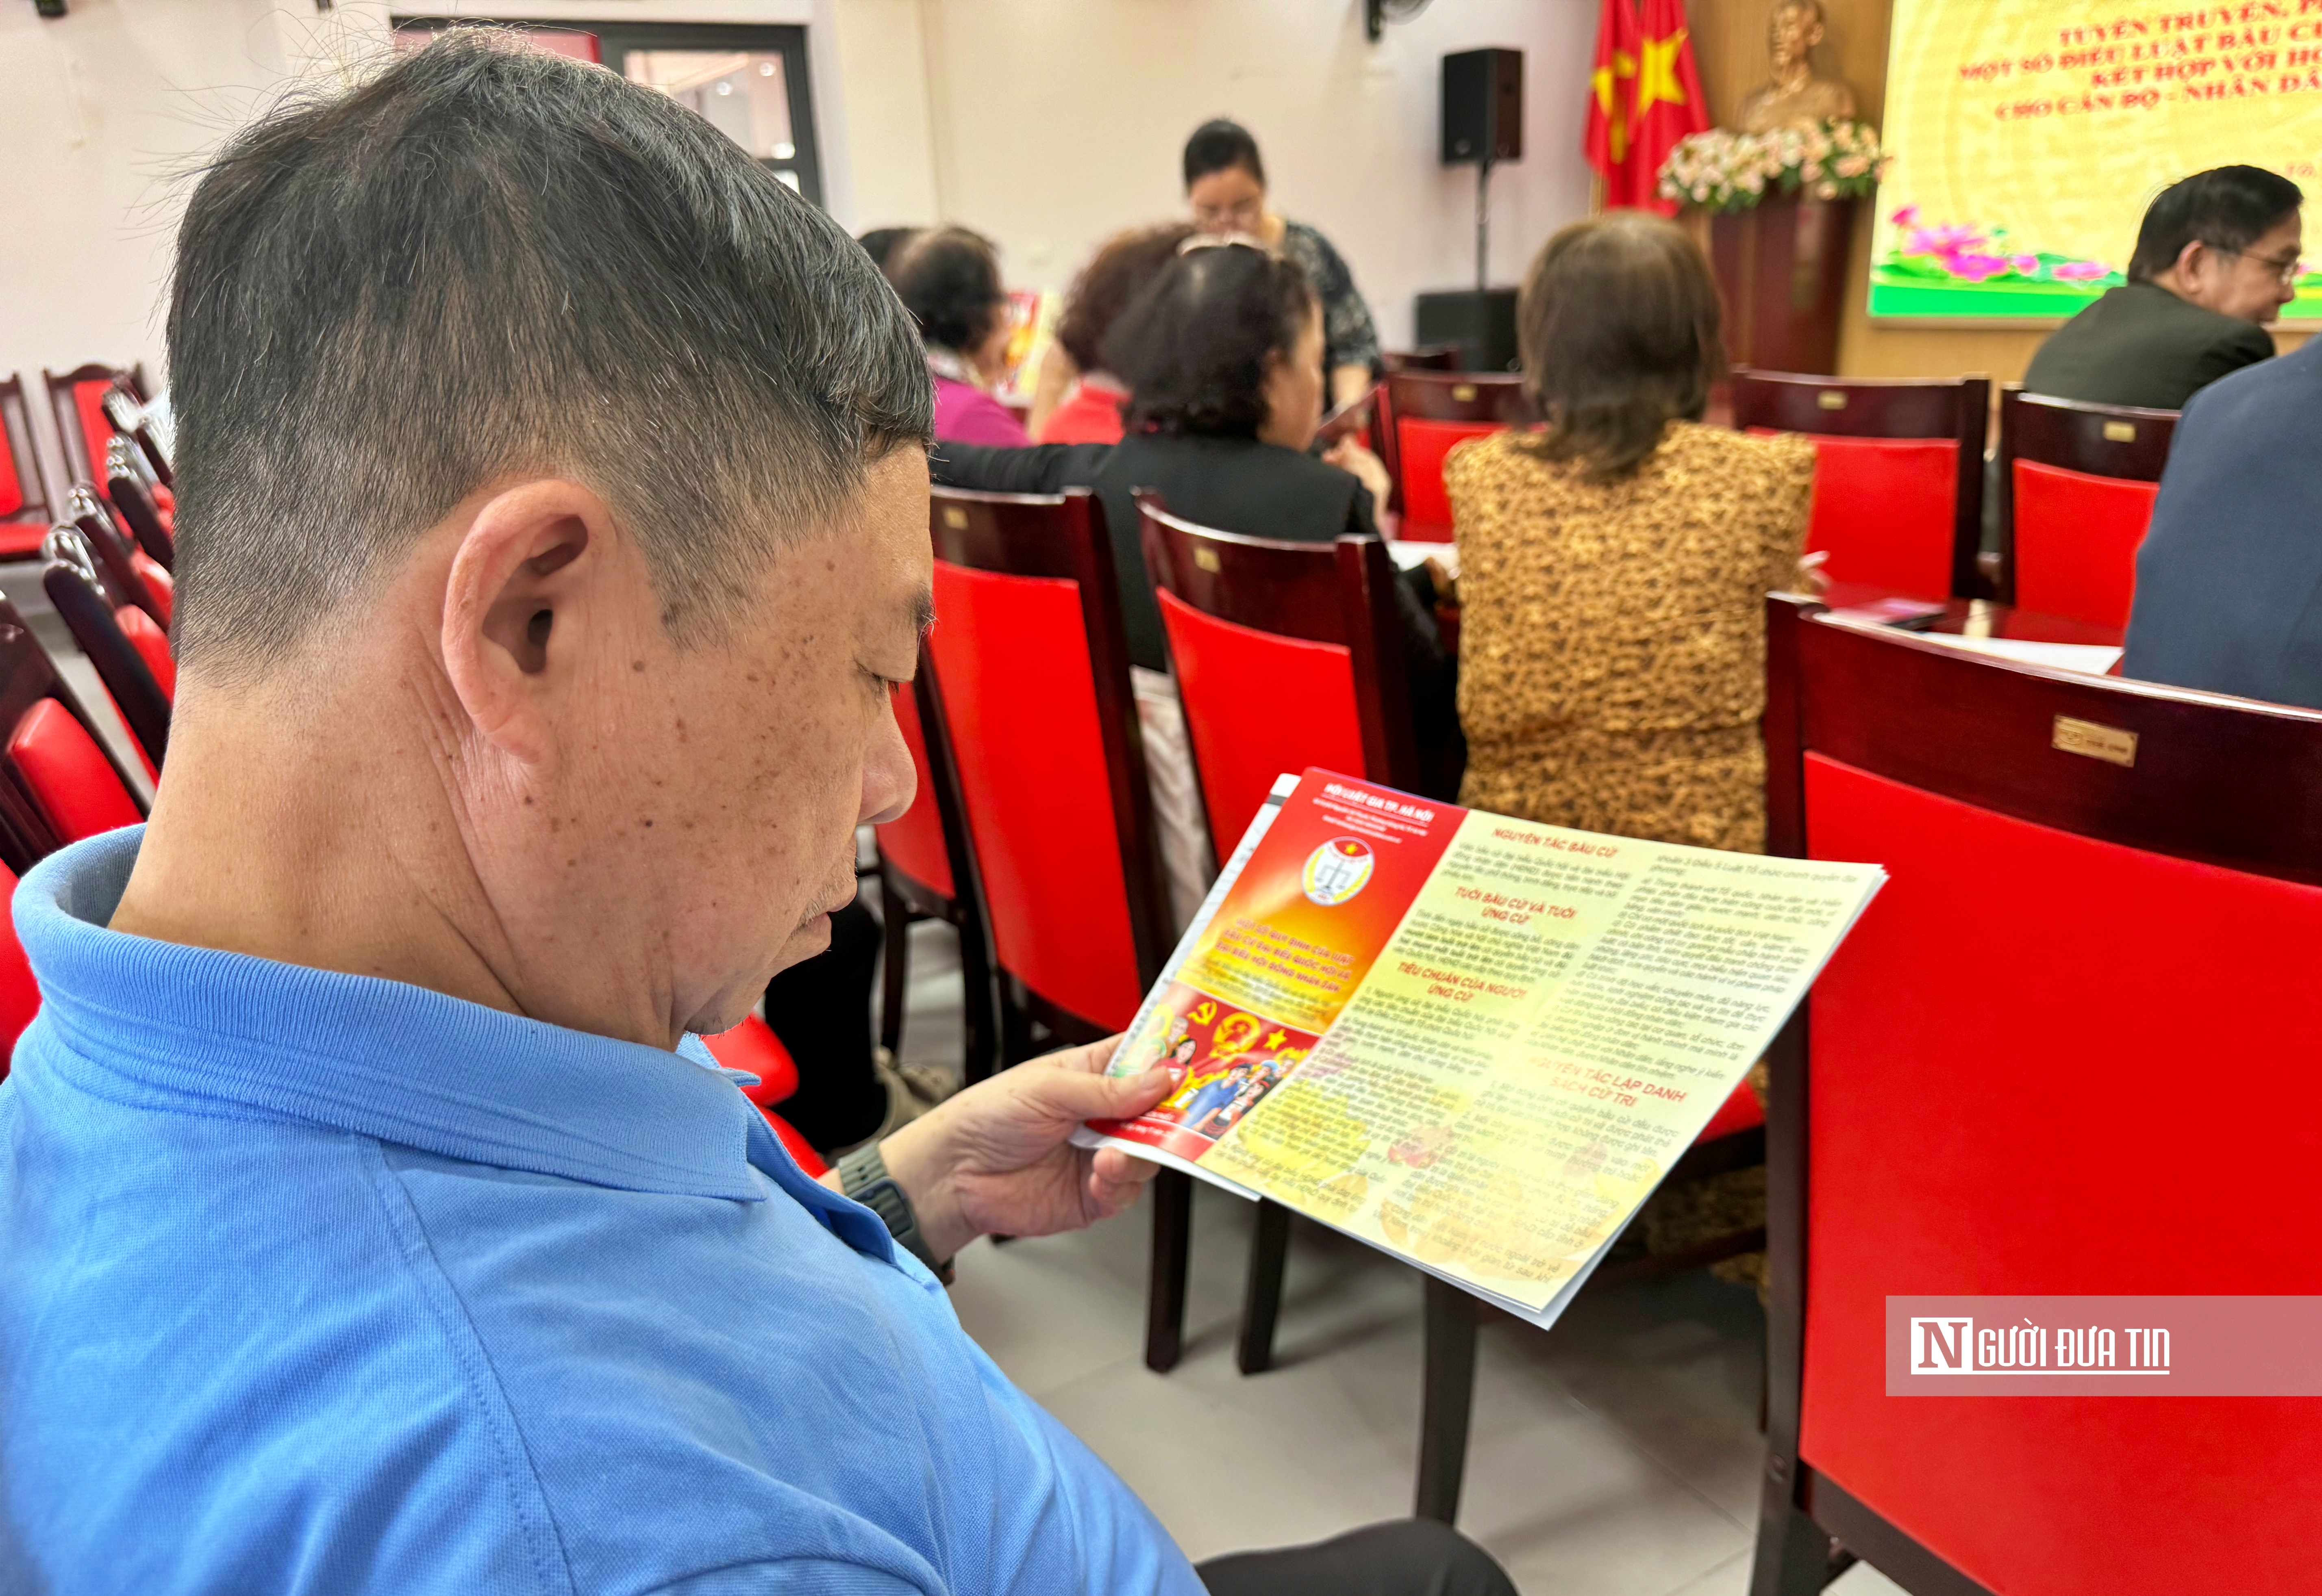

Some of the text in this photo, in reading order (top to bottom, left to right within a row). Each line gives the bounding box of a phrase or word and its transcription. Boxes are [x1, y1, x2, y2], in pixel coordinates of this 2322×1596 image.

[2131, 33, 2212, 61] LUẬT
[1994, 98, 2054, 122] CHO
[2181, 73, 2269, 103] NHÂN
[1584, 1068, 1611, 1083] TẮC
[1612, 1076, 1642, 1090] LẬP
[1643, 1084, 1687, 1101] DANH
[1614, 1092, 1637, 1107] TRI
